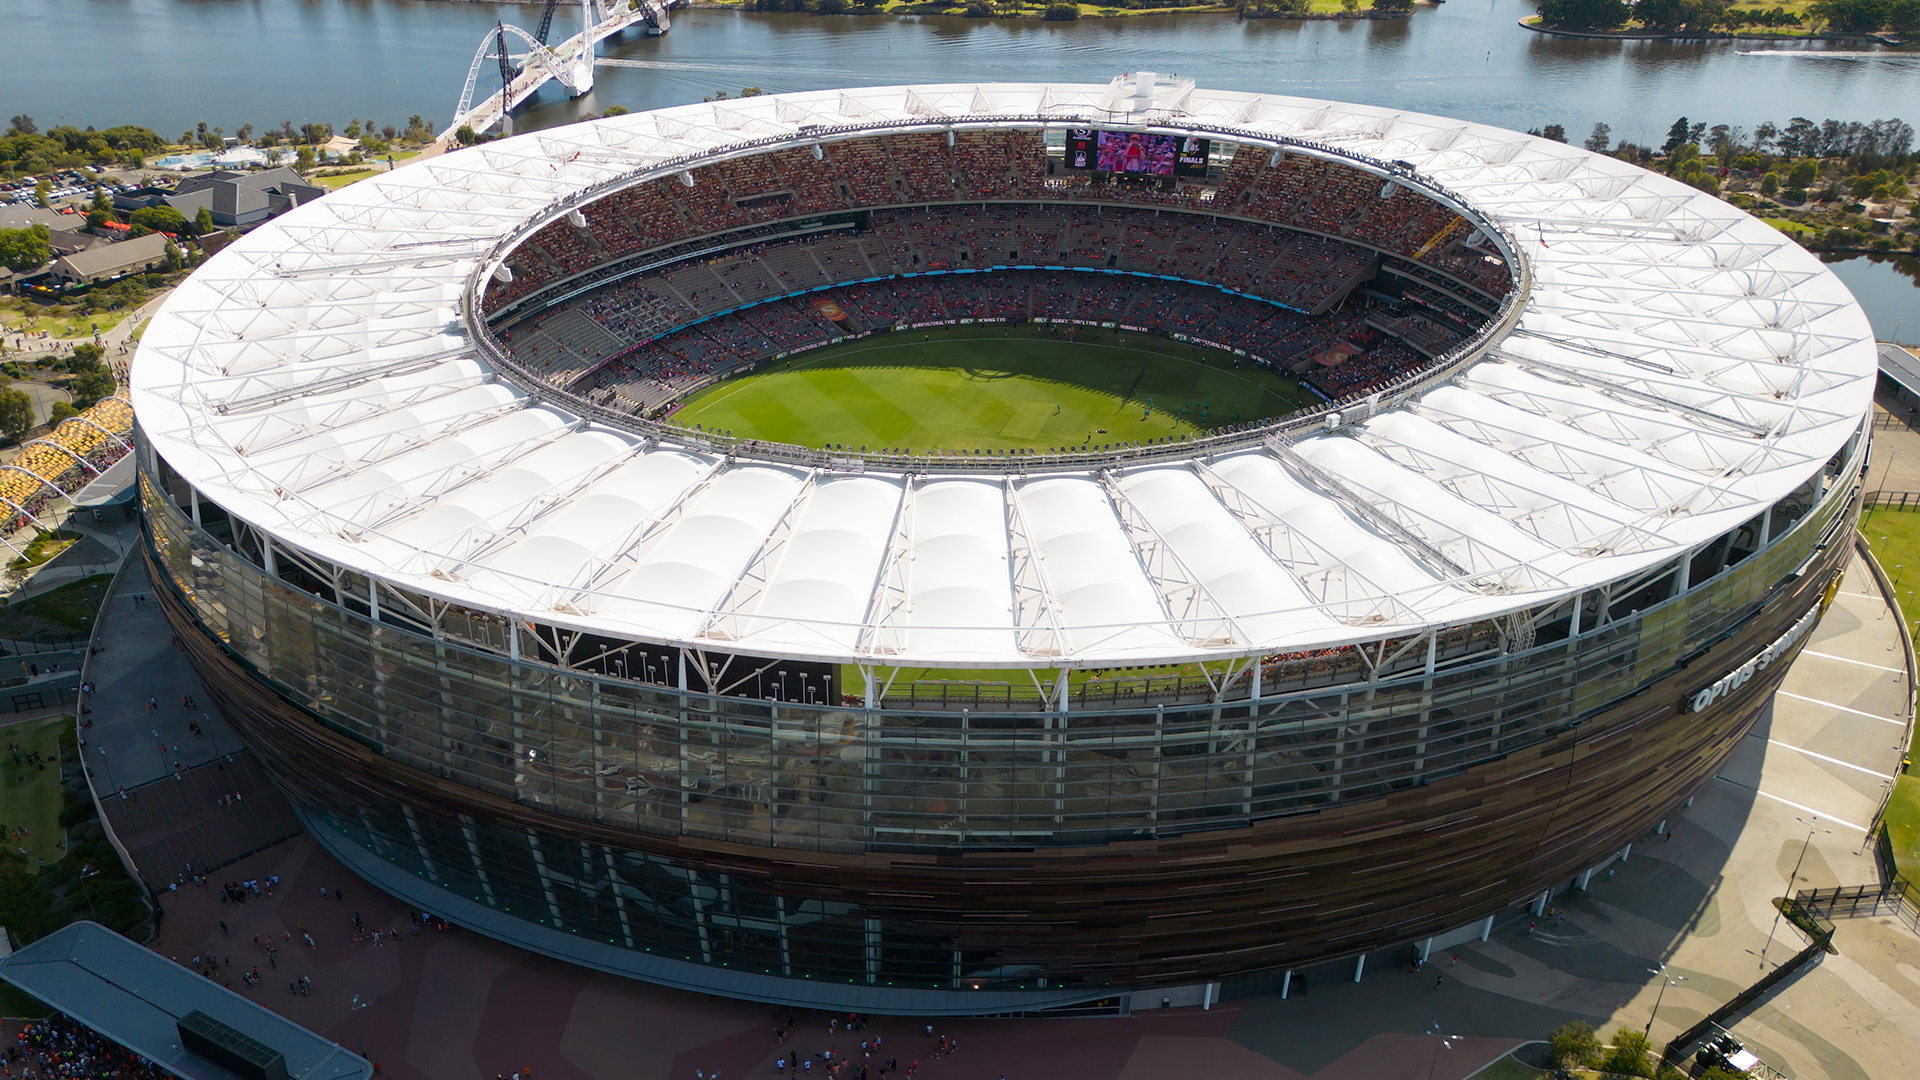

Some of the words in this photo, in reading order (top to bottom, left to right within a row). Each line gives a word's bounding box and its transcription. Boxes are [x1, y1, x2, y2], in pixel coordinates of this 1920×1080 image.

[1179, 156, 1204, 164] FINALS
[912, 320, 944, 328] AGRICULTURAL
[1120, 323, 1138, 332] MINING
[1693, 657, 1757, 712] OPTUS
